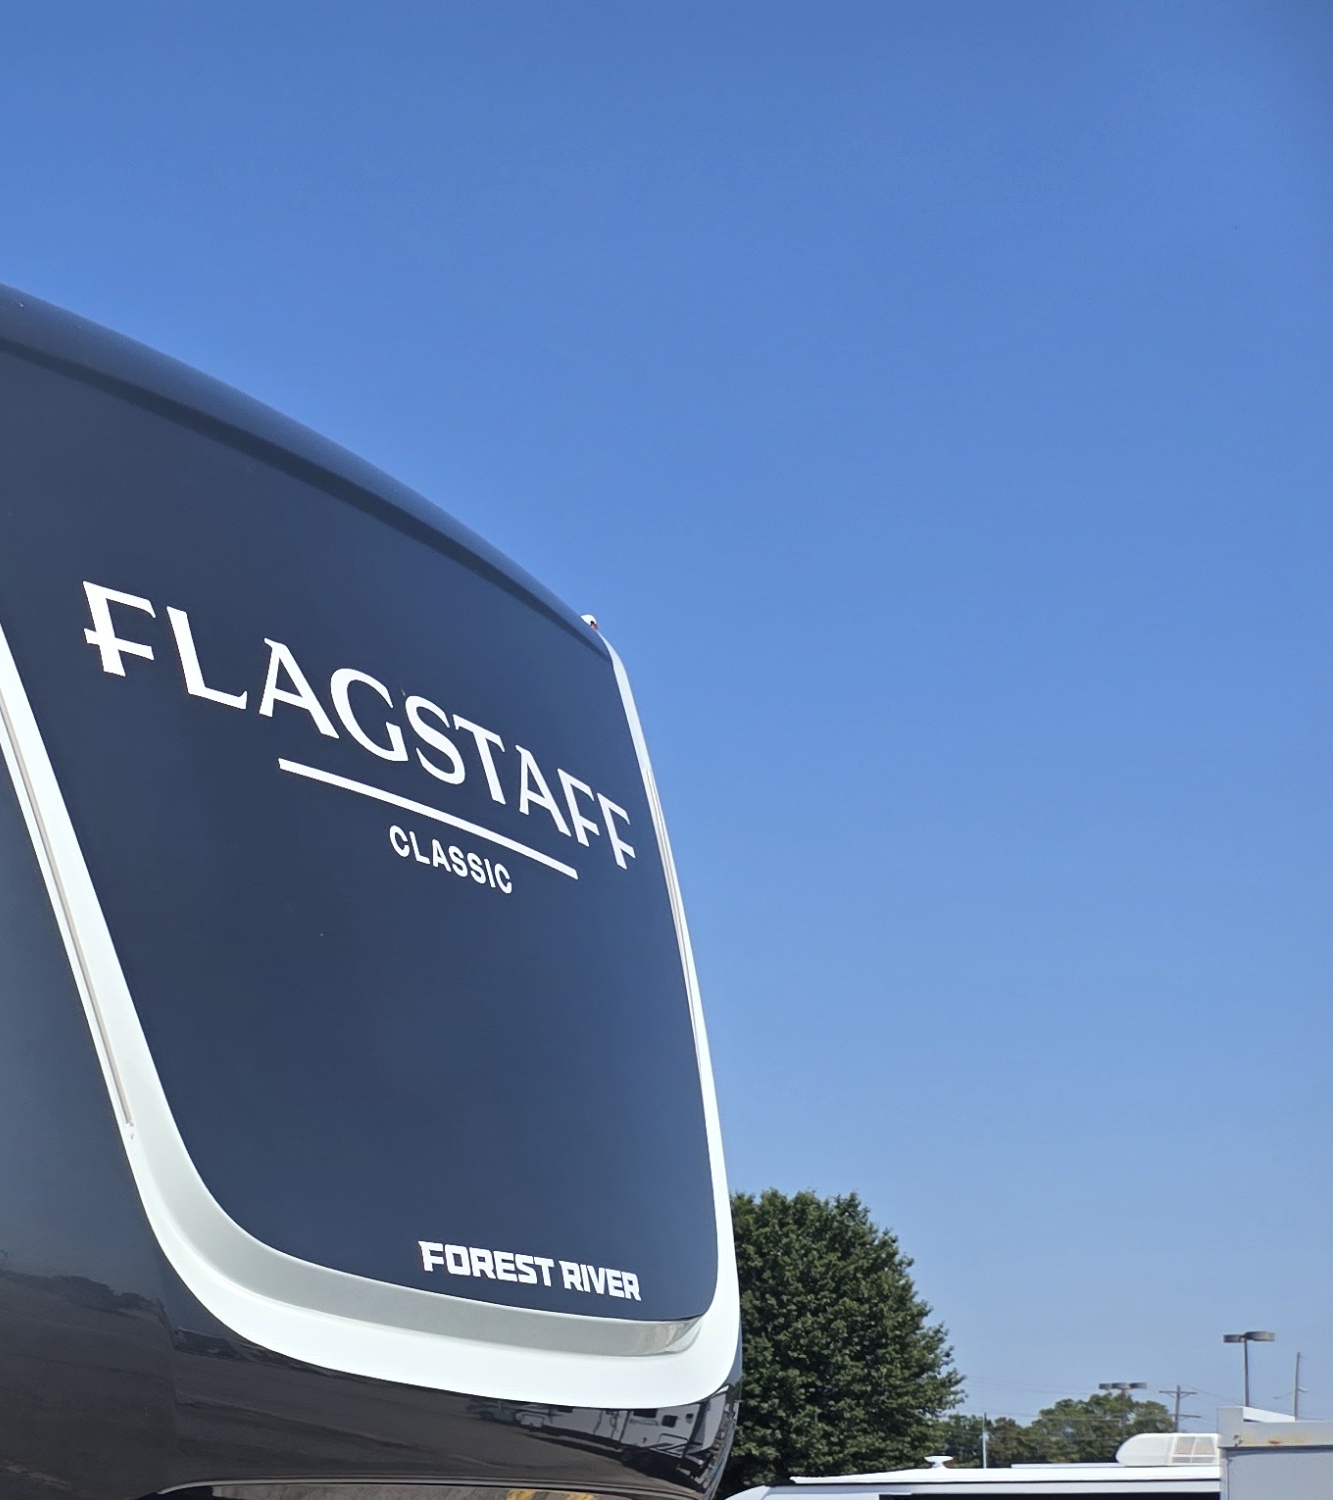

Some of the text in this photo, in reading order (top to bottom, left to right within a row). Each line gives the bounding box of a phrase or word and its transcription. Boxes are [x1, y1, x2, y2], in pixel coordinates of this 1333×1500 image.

[83, 580, 636, 870] FLAGSTAFF
[389, 825, 512, 894] CLASSIC
[418, 1240, 641, 1301] FOREST RIVER
